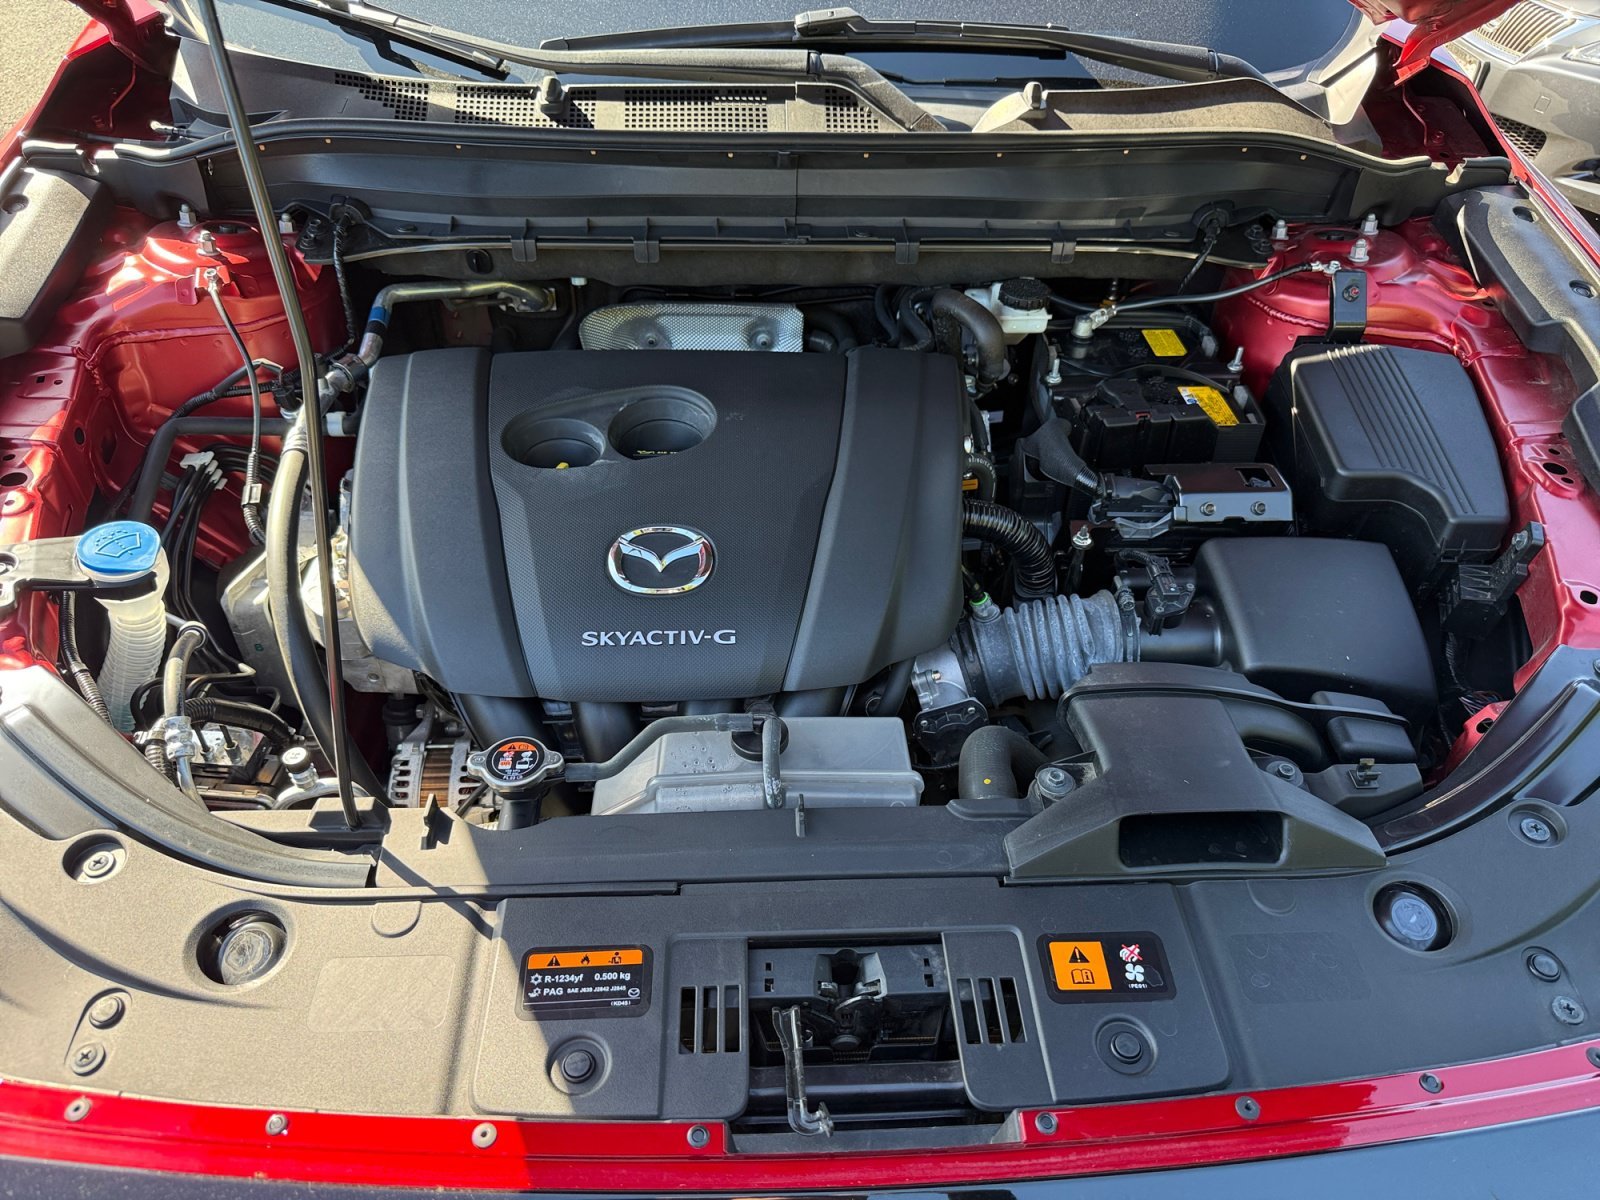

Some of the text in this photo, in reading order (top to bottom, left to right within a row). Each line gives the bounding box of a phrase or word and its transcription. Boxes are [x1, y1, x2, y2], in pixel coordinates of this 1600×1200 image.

[581, 629, 736, 646] SKYACTIV-G
[544, 971, 631, 984] R-1234yf 0.500 kg
[543, 987, 564, 996] PAG
